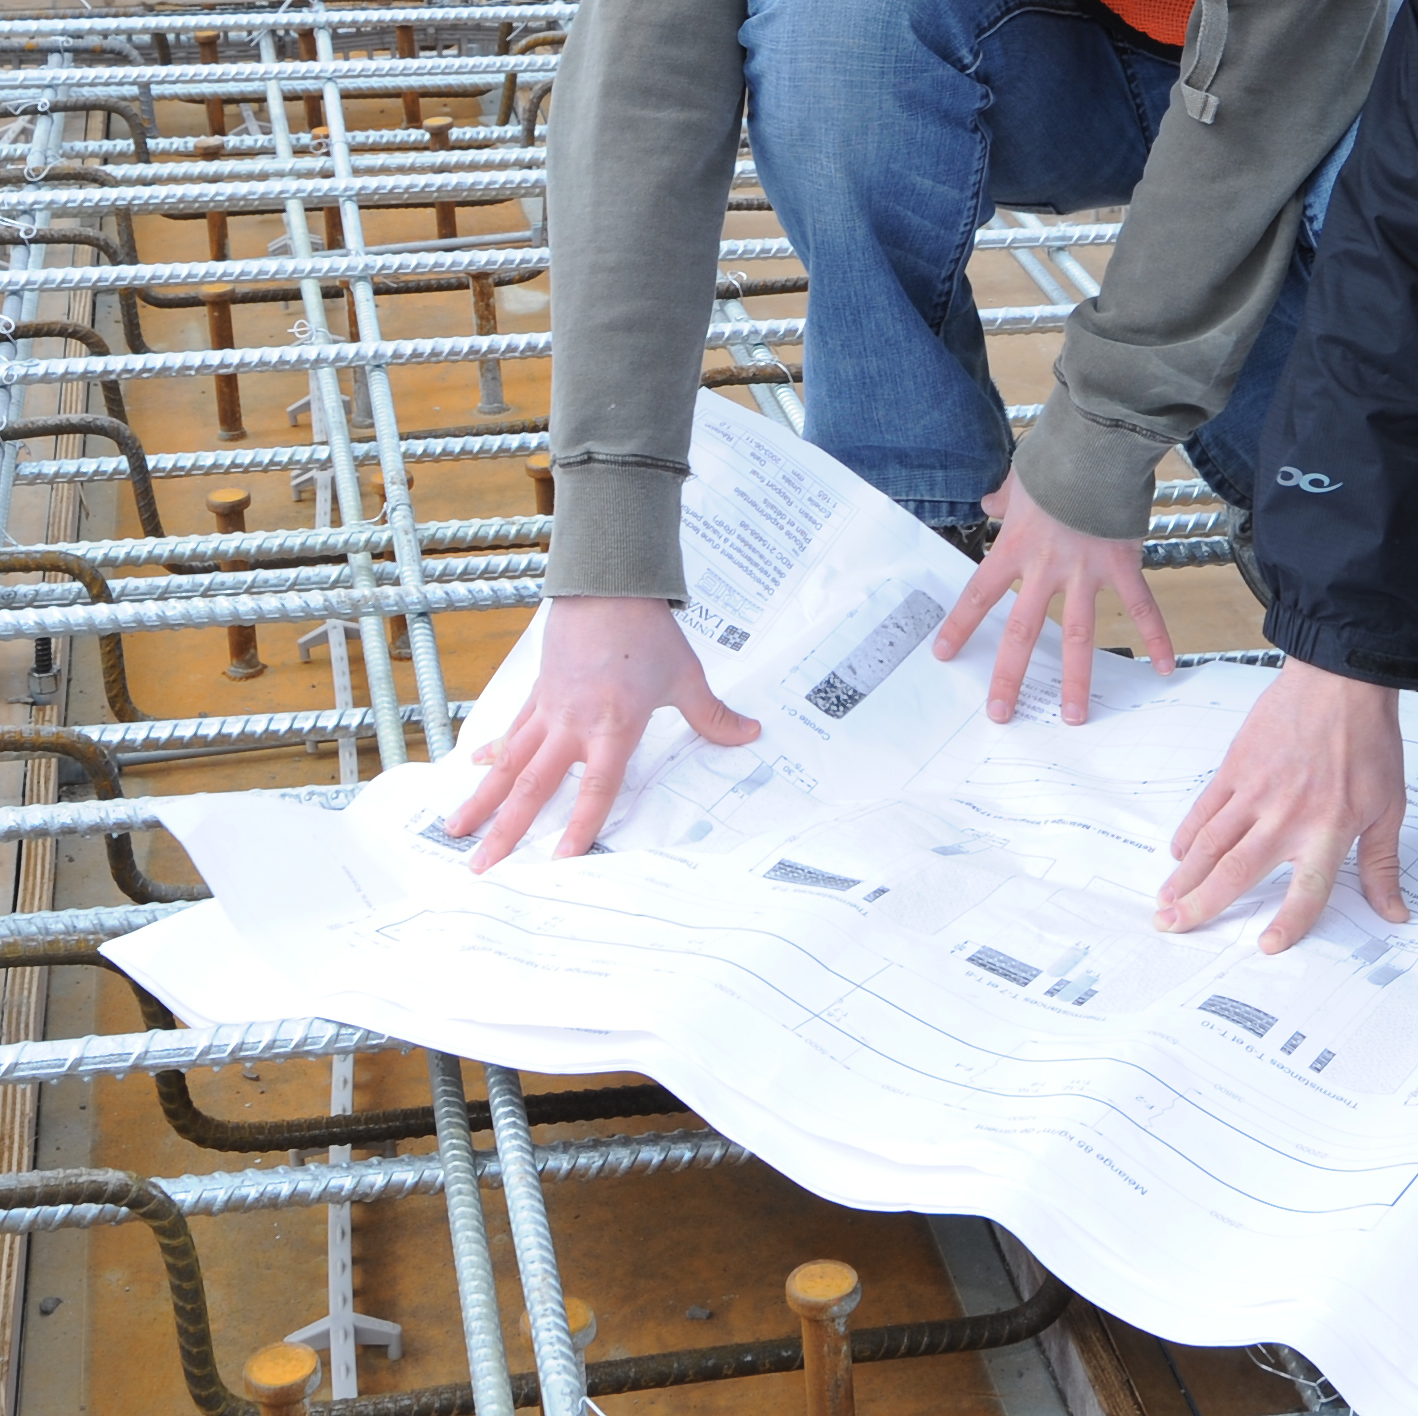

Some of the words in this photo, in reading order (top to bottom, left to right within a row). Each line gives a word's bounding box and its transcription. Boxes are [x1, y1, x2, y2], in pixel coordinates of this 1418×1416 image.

[750, 452, 767, 466] Date
[749, 468, 766, 483] final
[781, 474, 802, 494] Unités
[791, 470, 805, 482] mm
[765, 480, 794, 507] Rapport
[733, 487, 785, 531] expérimentale
[763, 498, 787, 520] détails
[807, 496, 832, 519] Échelle
[712, 514, 737, 536] (RHP)
[786, 518, 795, 527] et
[798, 508, 823, 531] Dessin
[702, 520, 723, 540] haute
[795, 526, 813, 544] Plan
[700, 532, 721, 550] d'une
[736, 534, 773, 566] chaussées
[784, 530, 807, 552] Route
[728, 542, 771, 578] retraitement
[775, 552, 794, 570] RDC
[720, 548, 775, 596] Développement
[773, 566, 786, 578] des
[771, 577, 781, 586] de
[781, 704, 798, 717] C-1
[799, 715, 831, 741] Carotte
[781, 764, 795, 776] 30
[1122, 838, 1156, 853] Retrait
[1201, 1020, 1228, 1038] T-10
[1231, 1035, 1244, 1045] et
[1245, 1045, 1265, 1061] T-9
[1270, 1058, 1358, 1109] Thermistances
[1077, 1140, 1094, 1153] 85
